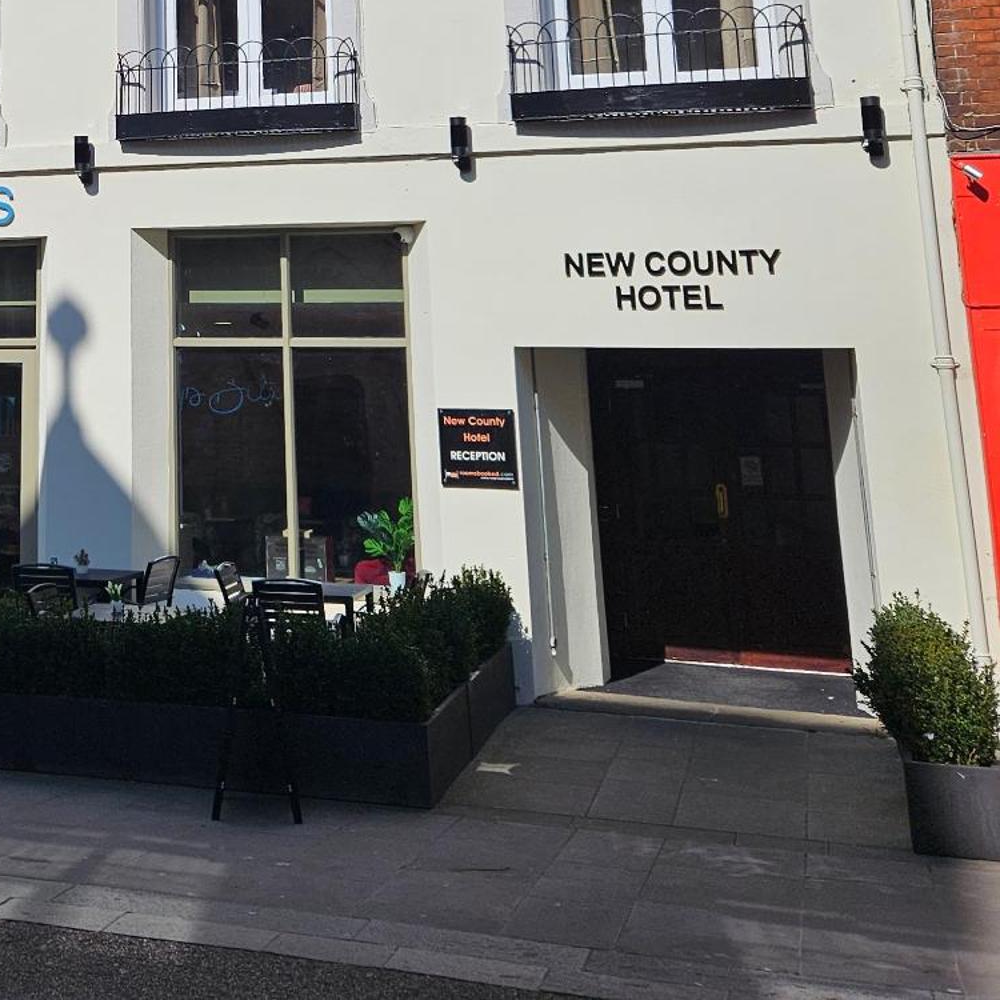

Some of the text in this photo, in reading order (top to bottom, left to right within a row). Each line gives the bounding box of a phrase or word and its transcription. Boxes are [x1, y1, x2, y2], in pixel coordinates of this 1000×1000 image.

[564, 249, 781, 278] NEW COUNTY
[615, 284, 724, 311] HOTEL
[443, 416, 506, 429] New County
[463, 432, 490, 443] Hotel
[450, 450, 506, 462] RECEPTION
